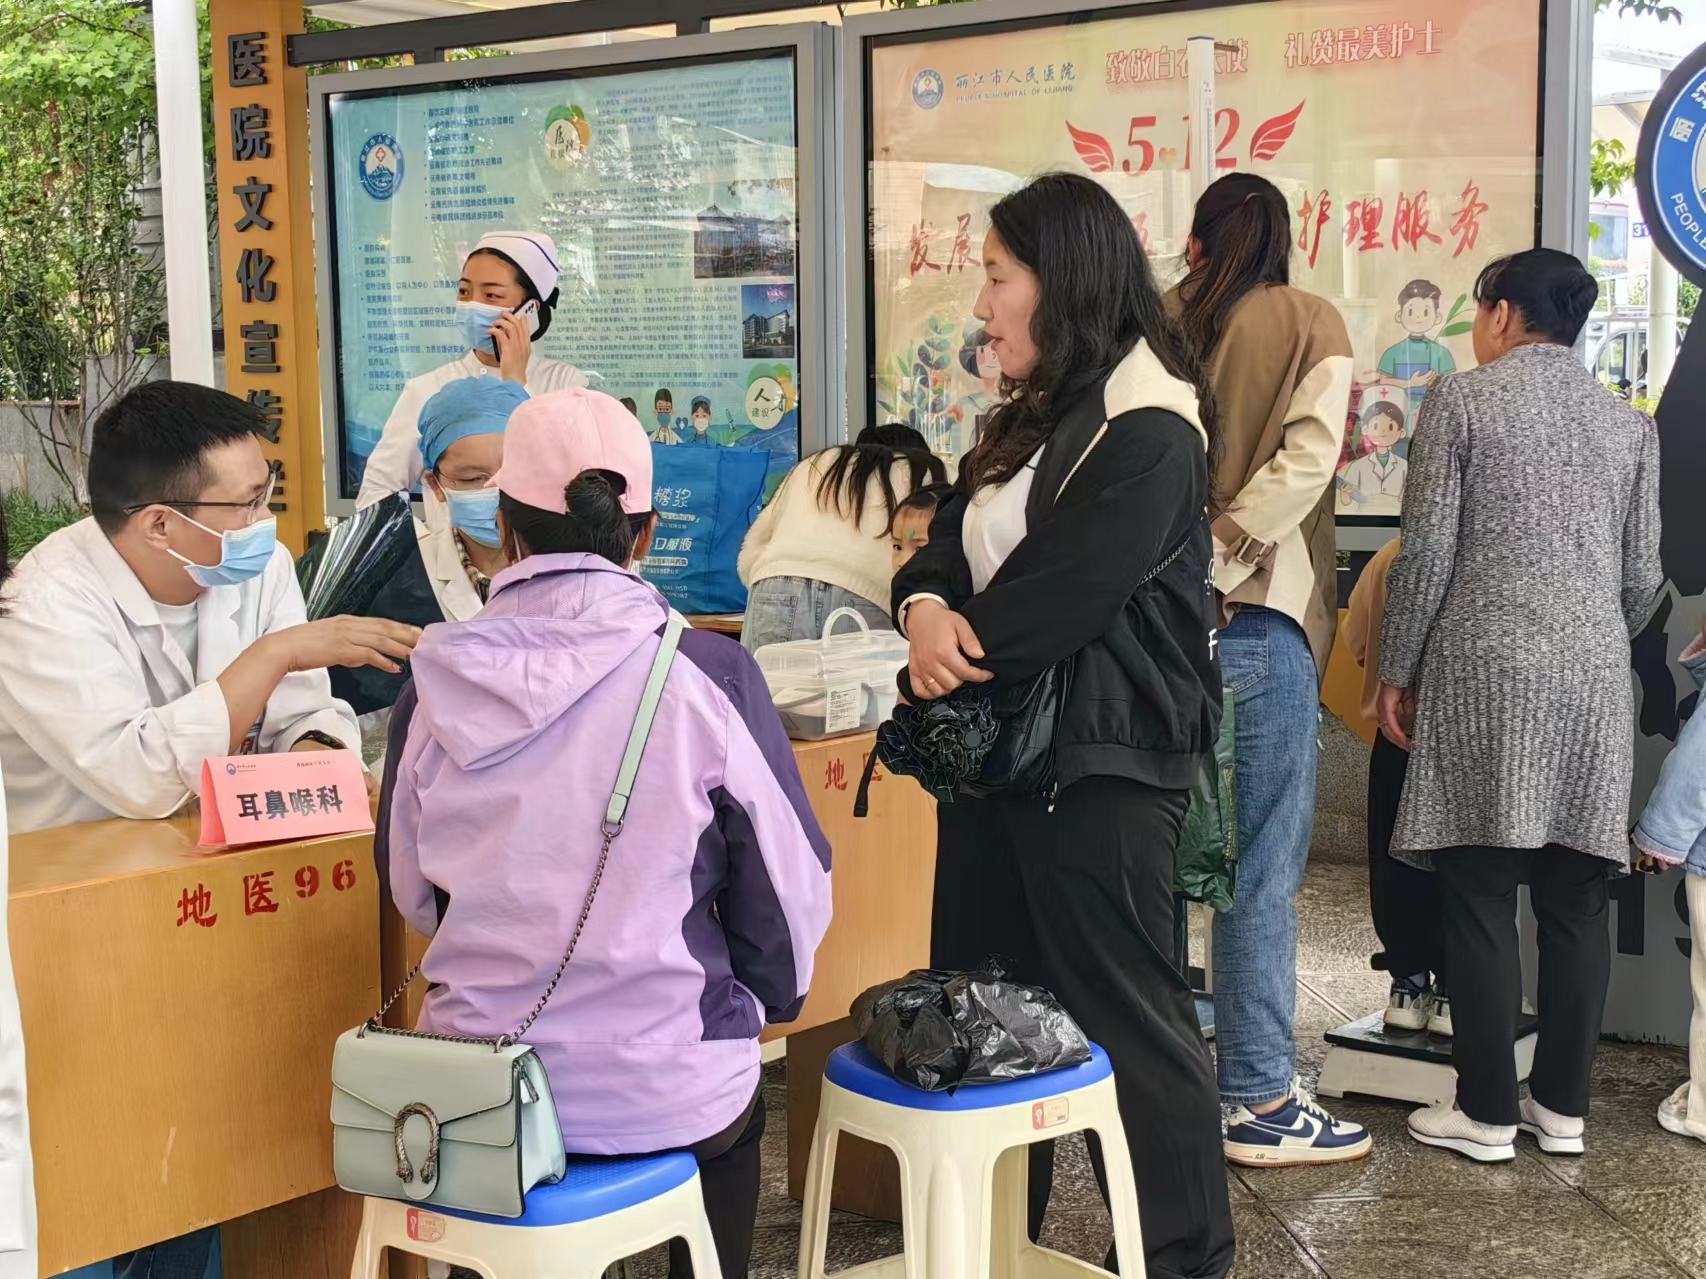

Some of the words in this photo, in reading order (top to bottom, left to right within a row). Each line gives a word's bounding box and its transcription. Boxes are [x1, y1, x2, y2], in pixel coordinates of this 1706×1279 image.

[1284, 20, 1442, 69] 礼赞最美护士
[956, 62, 1076, 91] 丽江市人民医院
[1296, 178, 1489, 270] 护理服务
[654, 486, 692, 508] 糖浆
[654, 537, 693, 552] 口服液
[236, 785, 344, 821] 耳鼻喉科
